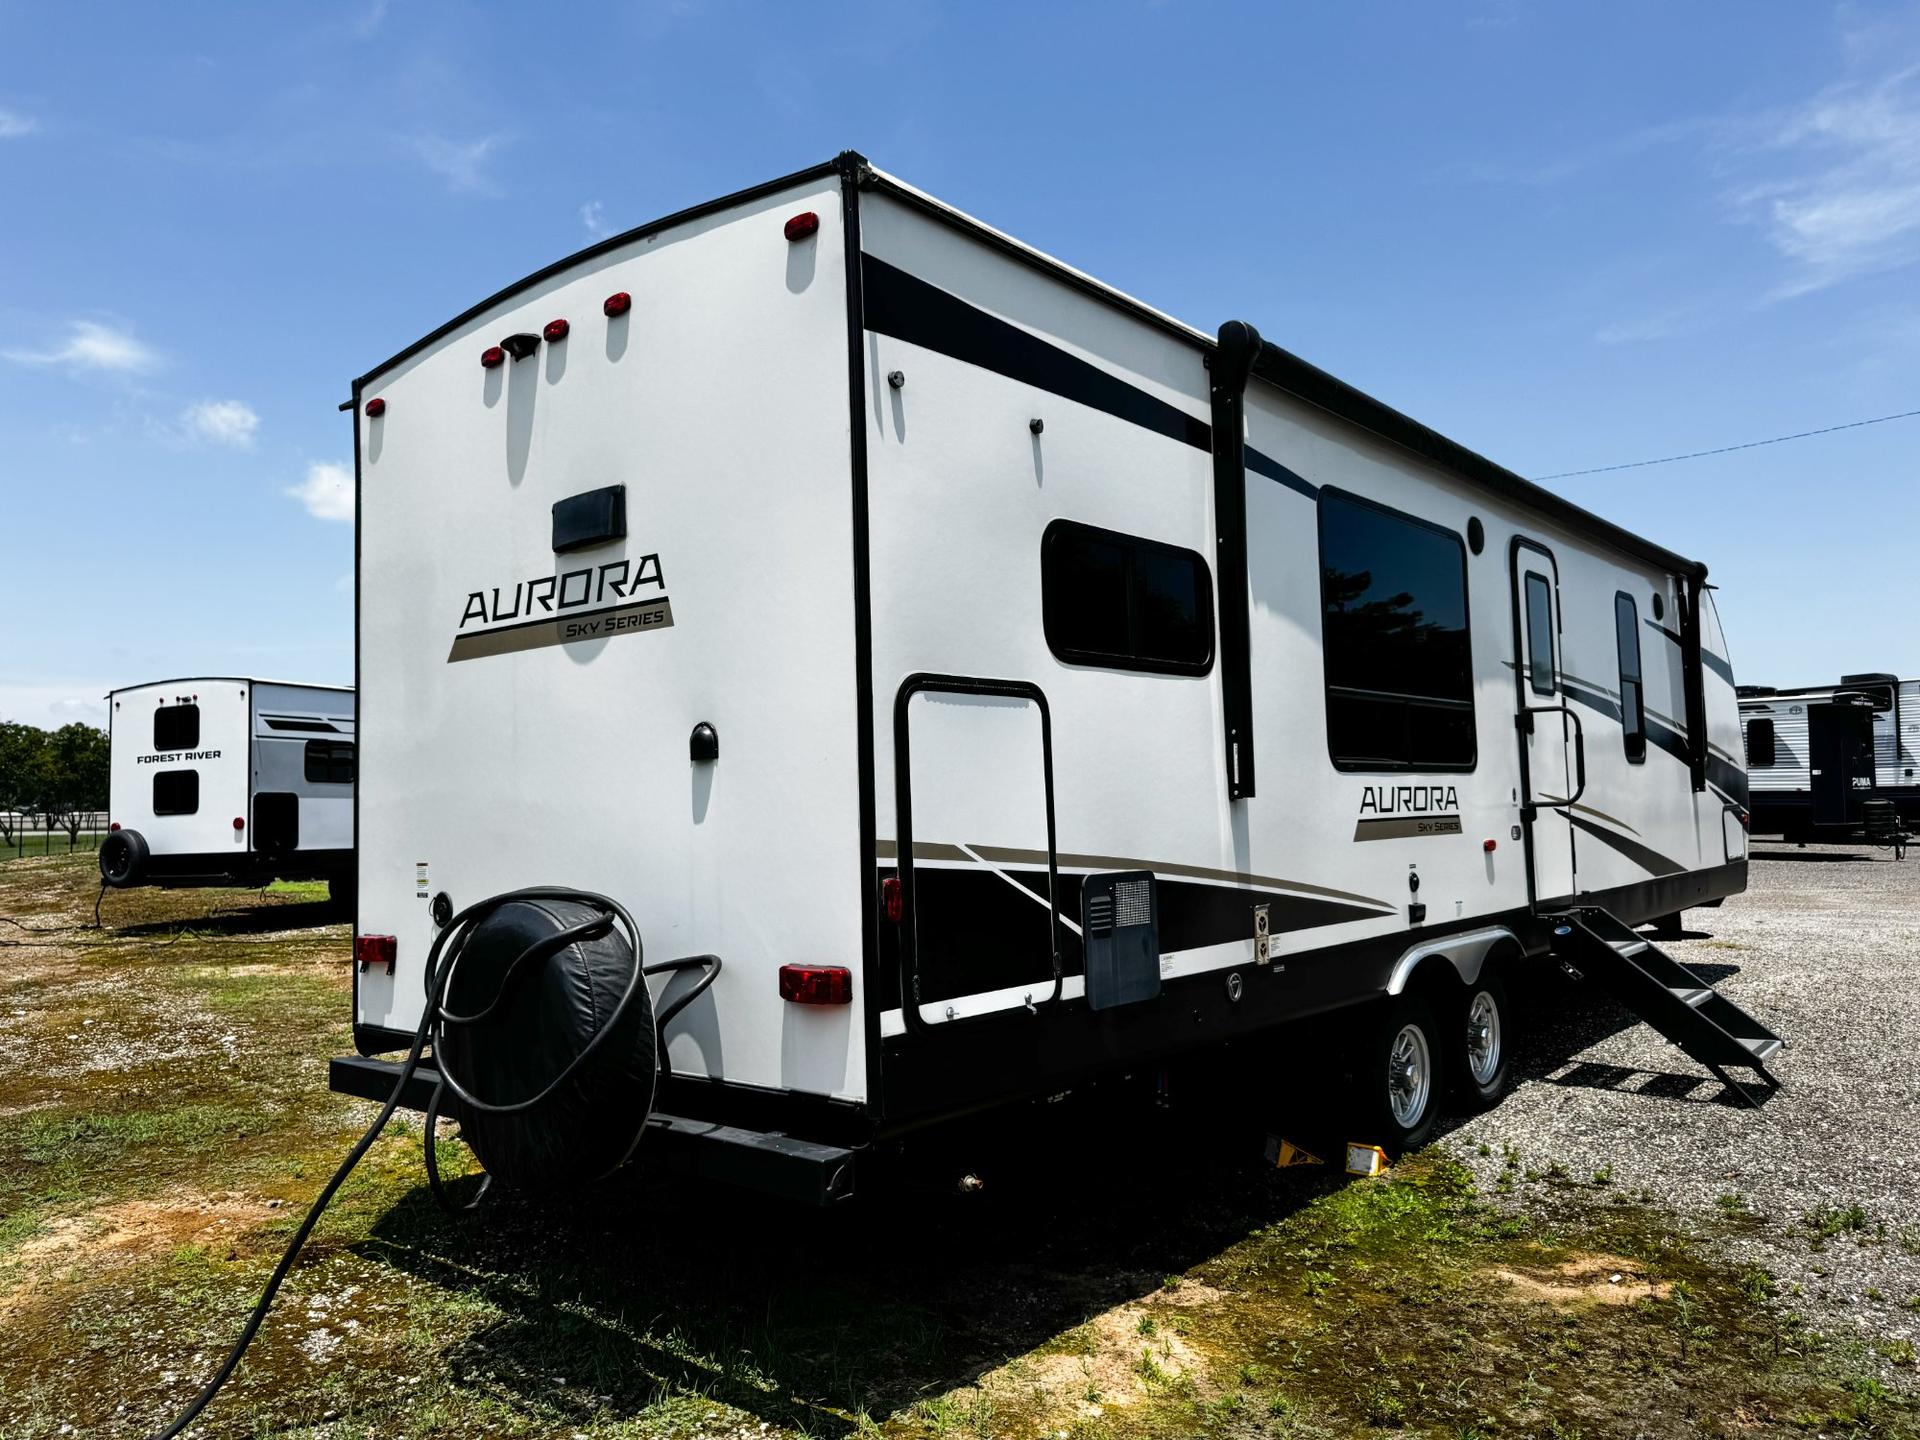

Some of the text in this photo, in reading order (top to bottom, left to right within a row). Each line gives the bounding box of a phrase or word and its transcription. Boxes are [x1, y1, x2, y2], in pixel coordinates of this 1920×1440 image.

[459, 553, 665, 628] AURORA
[566, 610, 664, 638] SKY SERIES
[137, 750, 221, 764] FOREST RIVER
[1360, 786, 1459, 814] AURORA
